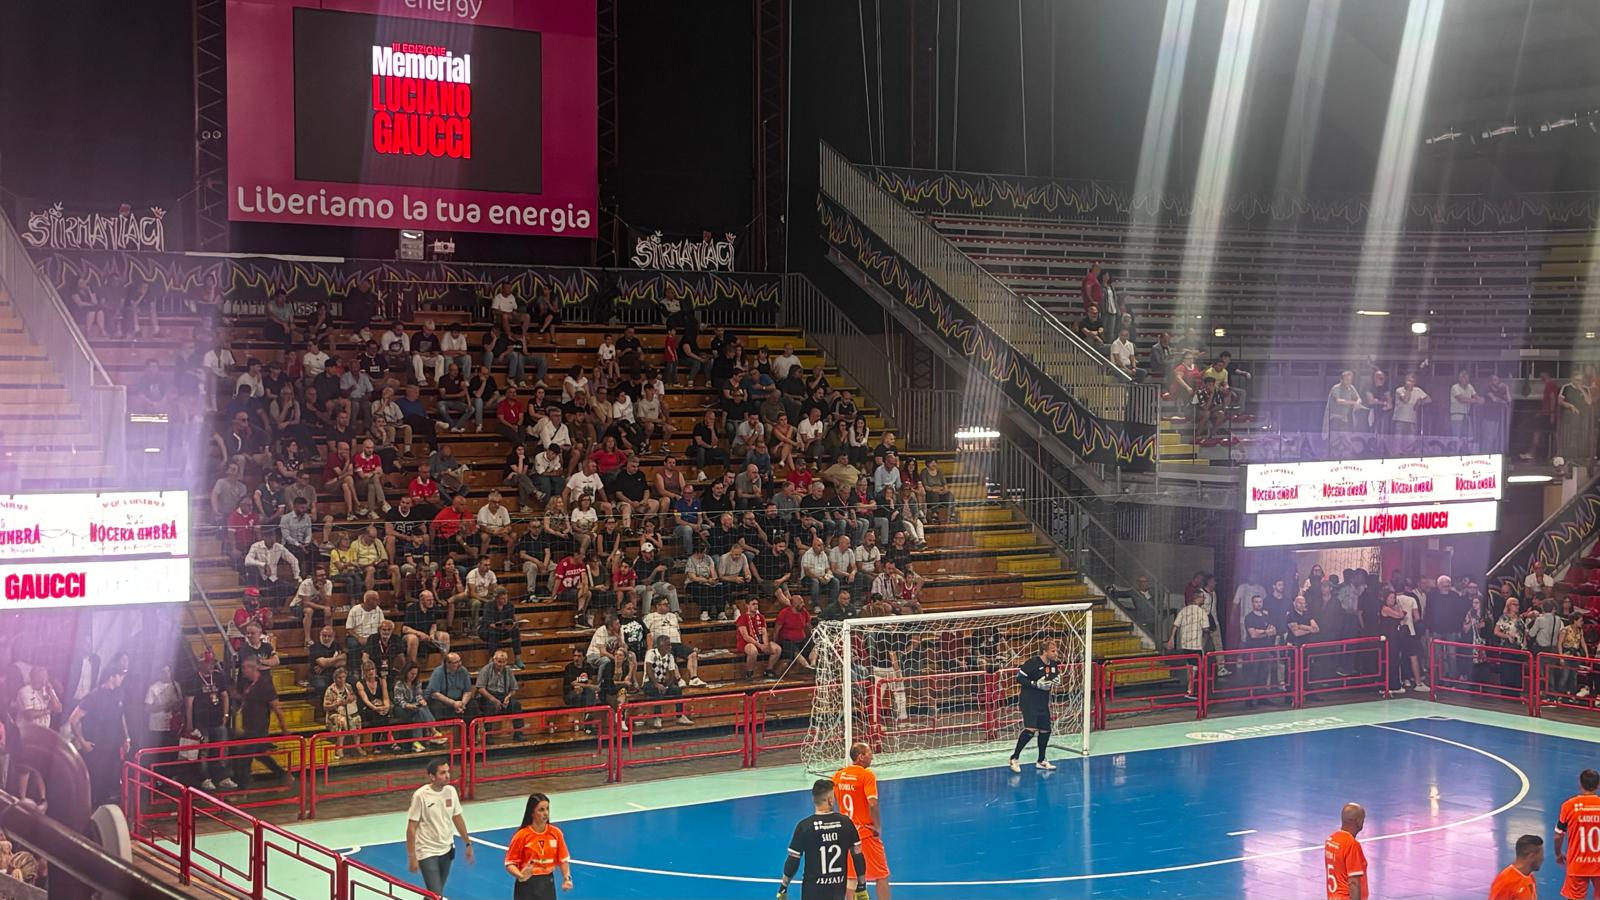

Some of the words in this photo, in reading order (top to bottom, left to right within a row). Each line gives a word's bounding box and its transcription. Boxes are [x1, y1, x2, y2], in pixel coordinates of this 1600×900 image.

[402, 43, 446, 56] EDIZIONE
[372, 45, 471, 84] Memorial
[372, 75, 471, 118] LUCIANO
[373, 111, 471, 159] GAUCCI
[237, 185, 395, 220] Liberiamo
[403, 194, 428, 220] la
[436, 198, 481, 223] tua
[488, 203, 591, 233] energia
[89, 521, 134, 543] NOCERA
[1302, 515, 1360, 537] Memorial
[1363, 514, 1408, 536] LUCIANO
[1411, 511, 1449, 530] GAUCCI
[5, 572, 86, 600] GAUCCI
[842, 794, 854, 819] 9
[1579, 826, 1600, 853] 10
[819, 844, 842, 874] 12
[1327, 864, 1338, 893] 5
